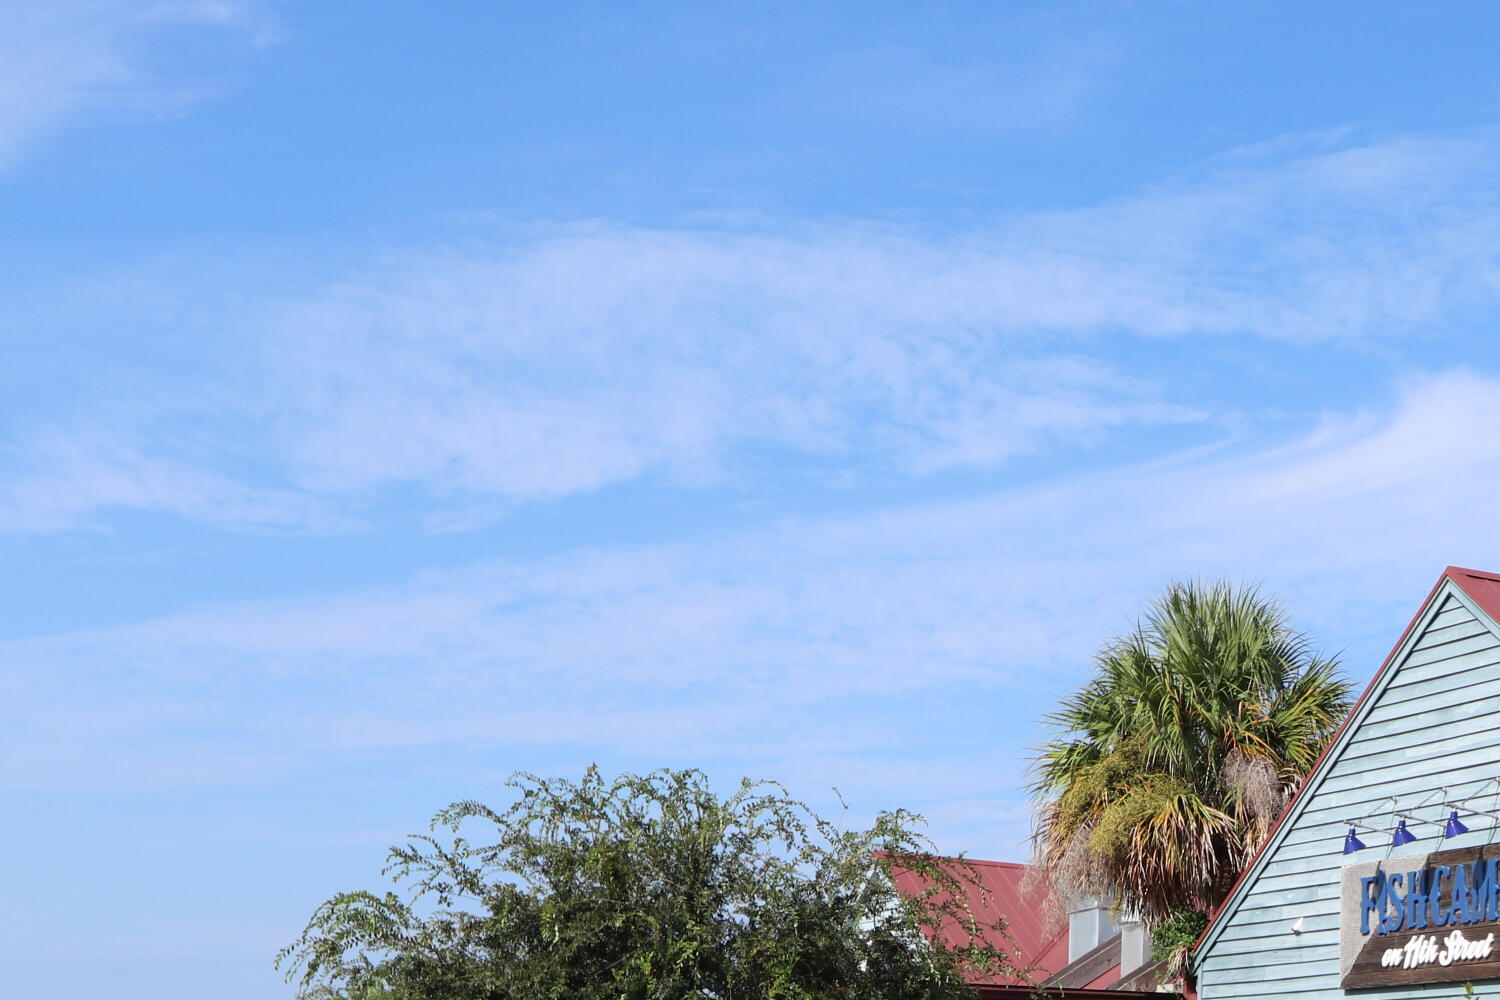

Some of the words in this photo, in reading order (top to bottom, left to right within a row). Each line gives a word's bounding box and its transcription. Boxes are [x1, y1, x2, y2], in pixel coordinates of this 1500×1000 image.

[1381, 948, 1404, 968] on
[1403, 934, 1440, 970] 11th
[1438, 929, 1495, 967] Street
